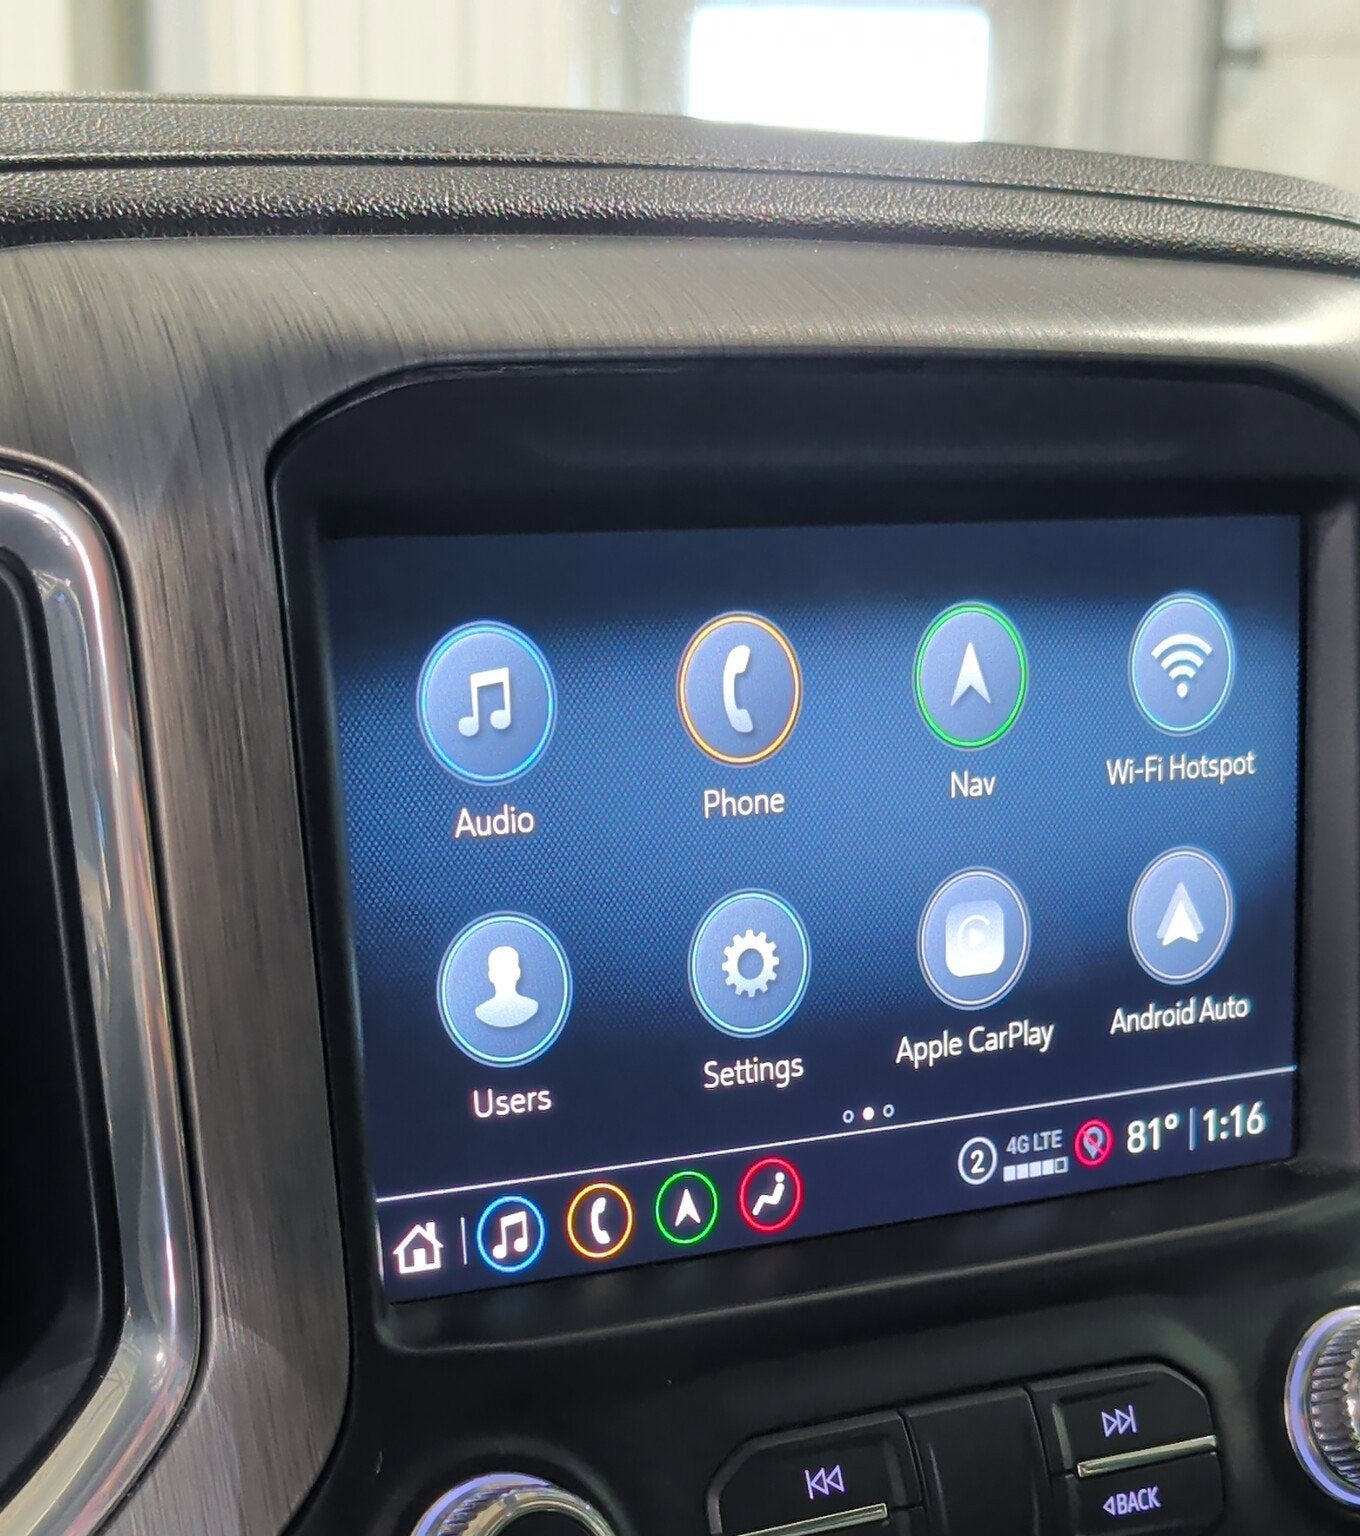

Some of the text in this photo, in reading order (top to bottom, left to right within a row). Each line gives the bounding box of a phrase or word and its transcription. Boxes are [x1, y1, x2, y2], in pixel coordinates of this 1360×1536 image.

[1106, 751, 1255, 785] Wi-Fi Hotspot
[950, 770, 996, 799] Nav
[703, 787, 785, 819] Phone
[454, 805, 534, 839] Audio
[1109, 995, 1250, 1035] Android Auto
[895, 1019, 1055, 1069] Apple CarPlay
[703, 1056, 804, 1089] Settings
[473, 1087, 552, 1119] Users
[1202, 1100, 1267, 1143] 1:16
[1005, 1129, 1064, 1155] 4G LTE
[969, 1149, 985, 1175] 2
[1116, 1486, 1161, 1514] BACK
